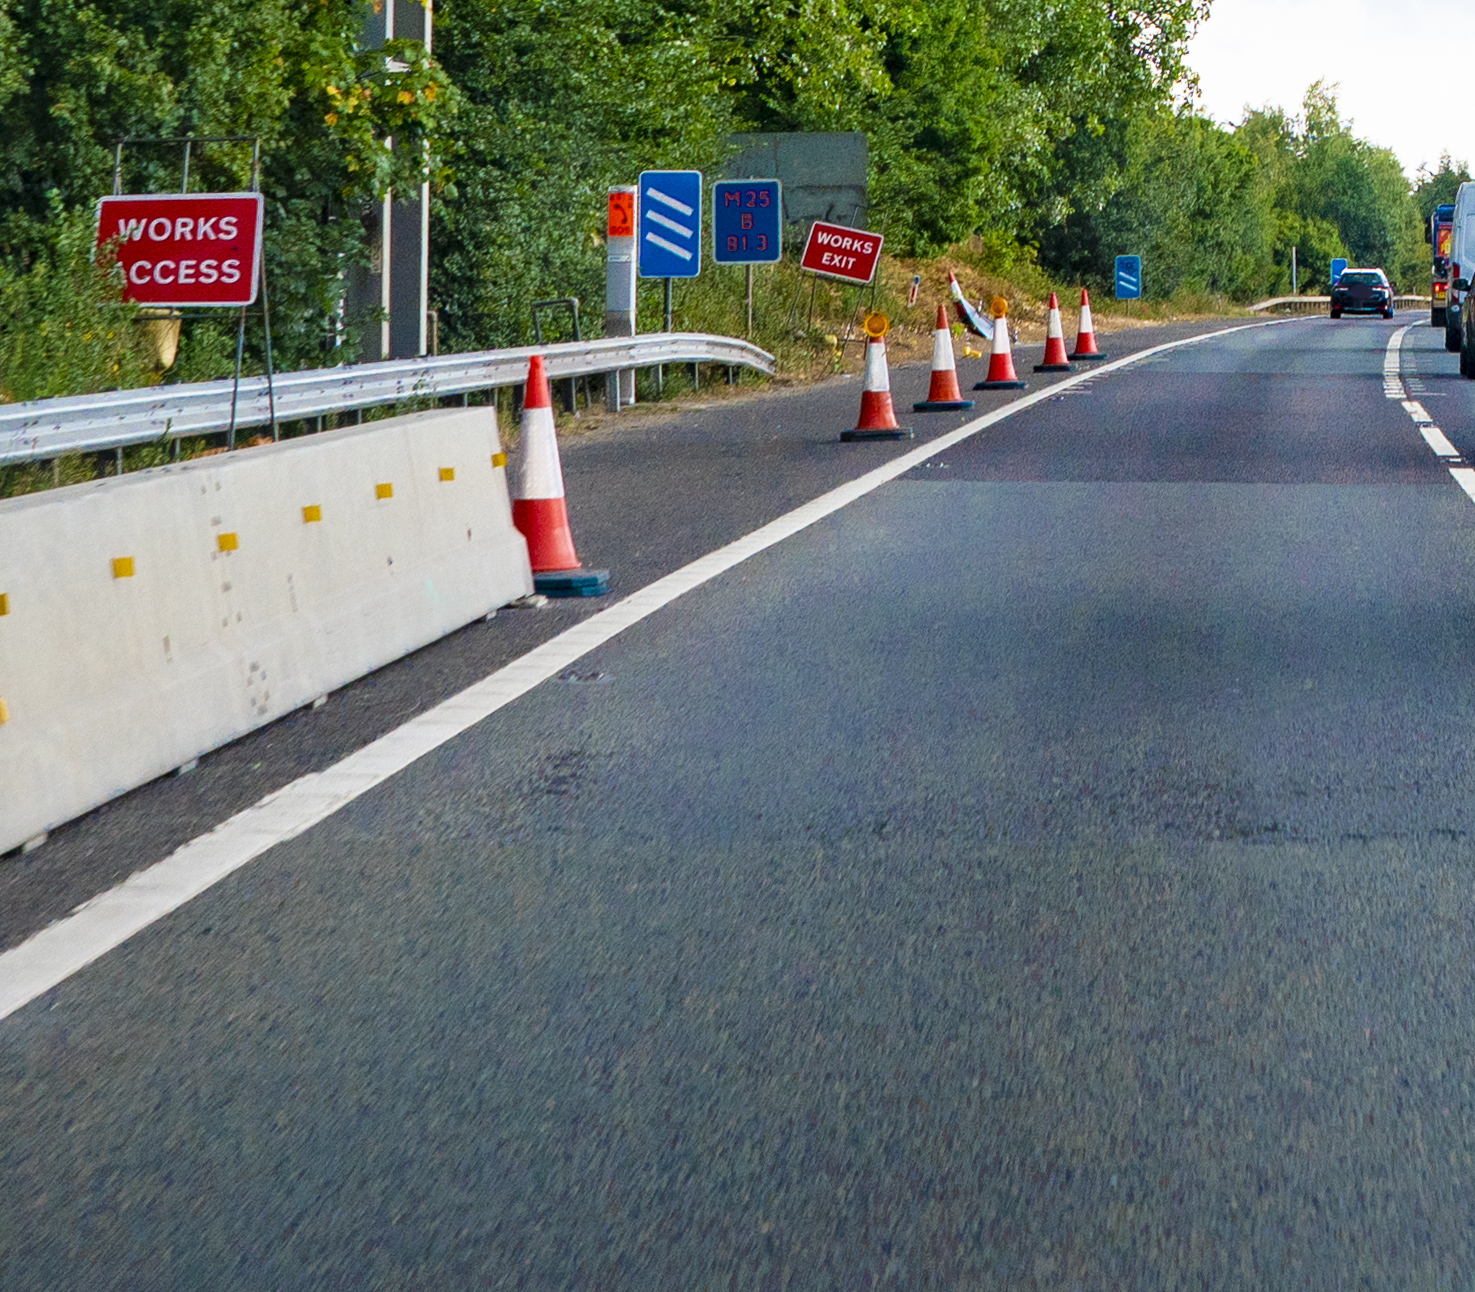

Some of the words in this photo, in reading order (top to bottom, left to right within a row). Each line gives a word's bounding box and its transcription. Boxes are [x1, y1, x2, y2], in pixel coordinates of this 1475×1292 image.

[118, 216, 238, 244] WORKS
[741, 213, 753, 229] B
[817, 231, 873, 254] WORKS
[821, 252, 856, 270] EXIT
